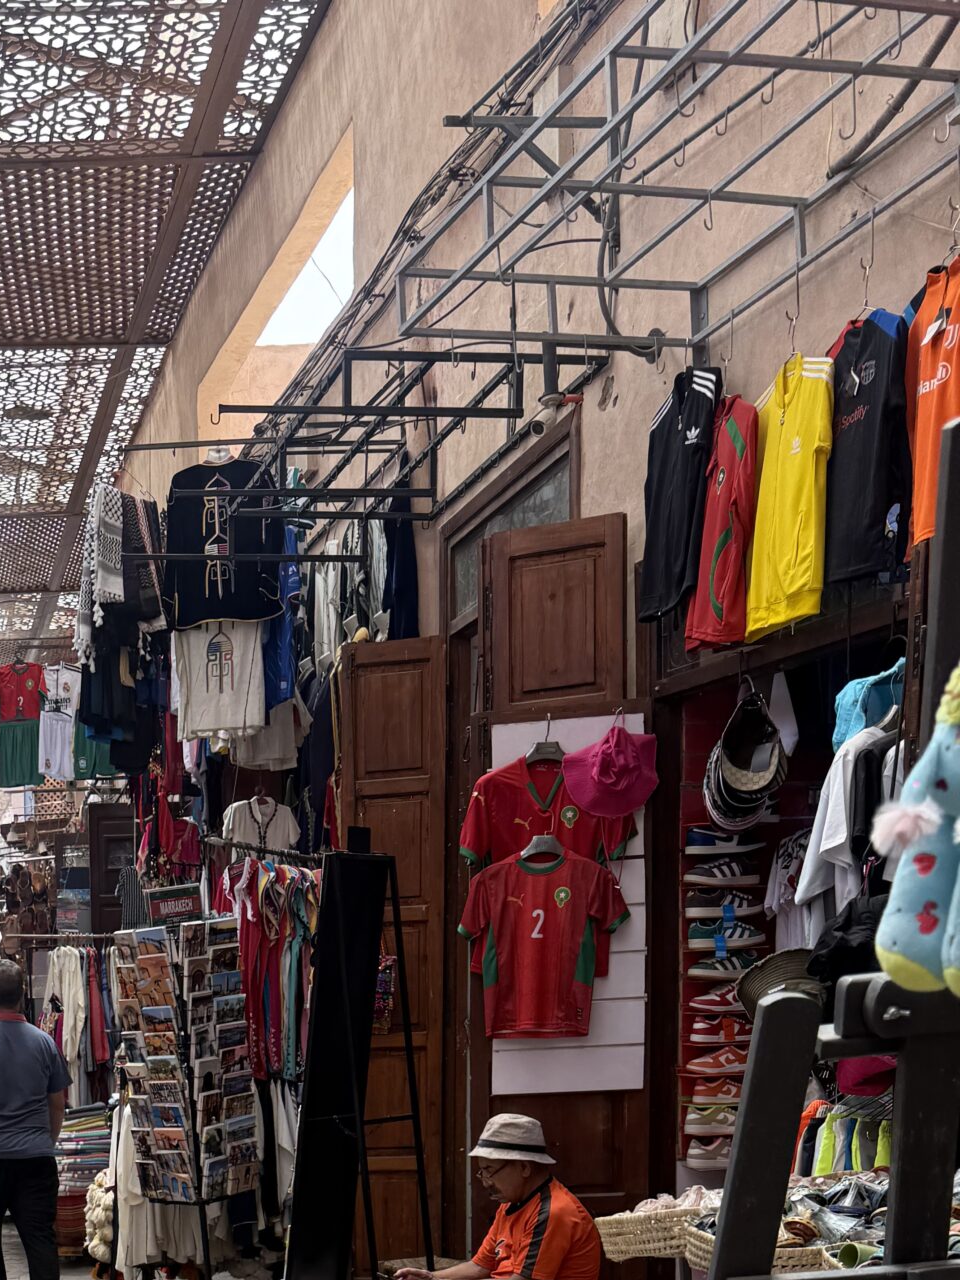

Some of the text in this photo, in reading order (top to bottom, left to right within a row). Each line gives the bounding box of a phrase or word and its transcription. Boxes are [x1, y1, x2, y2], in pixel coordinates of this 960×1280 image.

[841, 405, 867, 429] Spotify
[159, 898, 193, 915] MARRAKECH
[530, 908, 544, 939] 2
